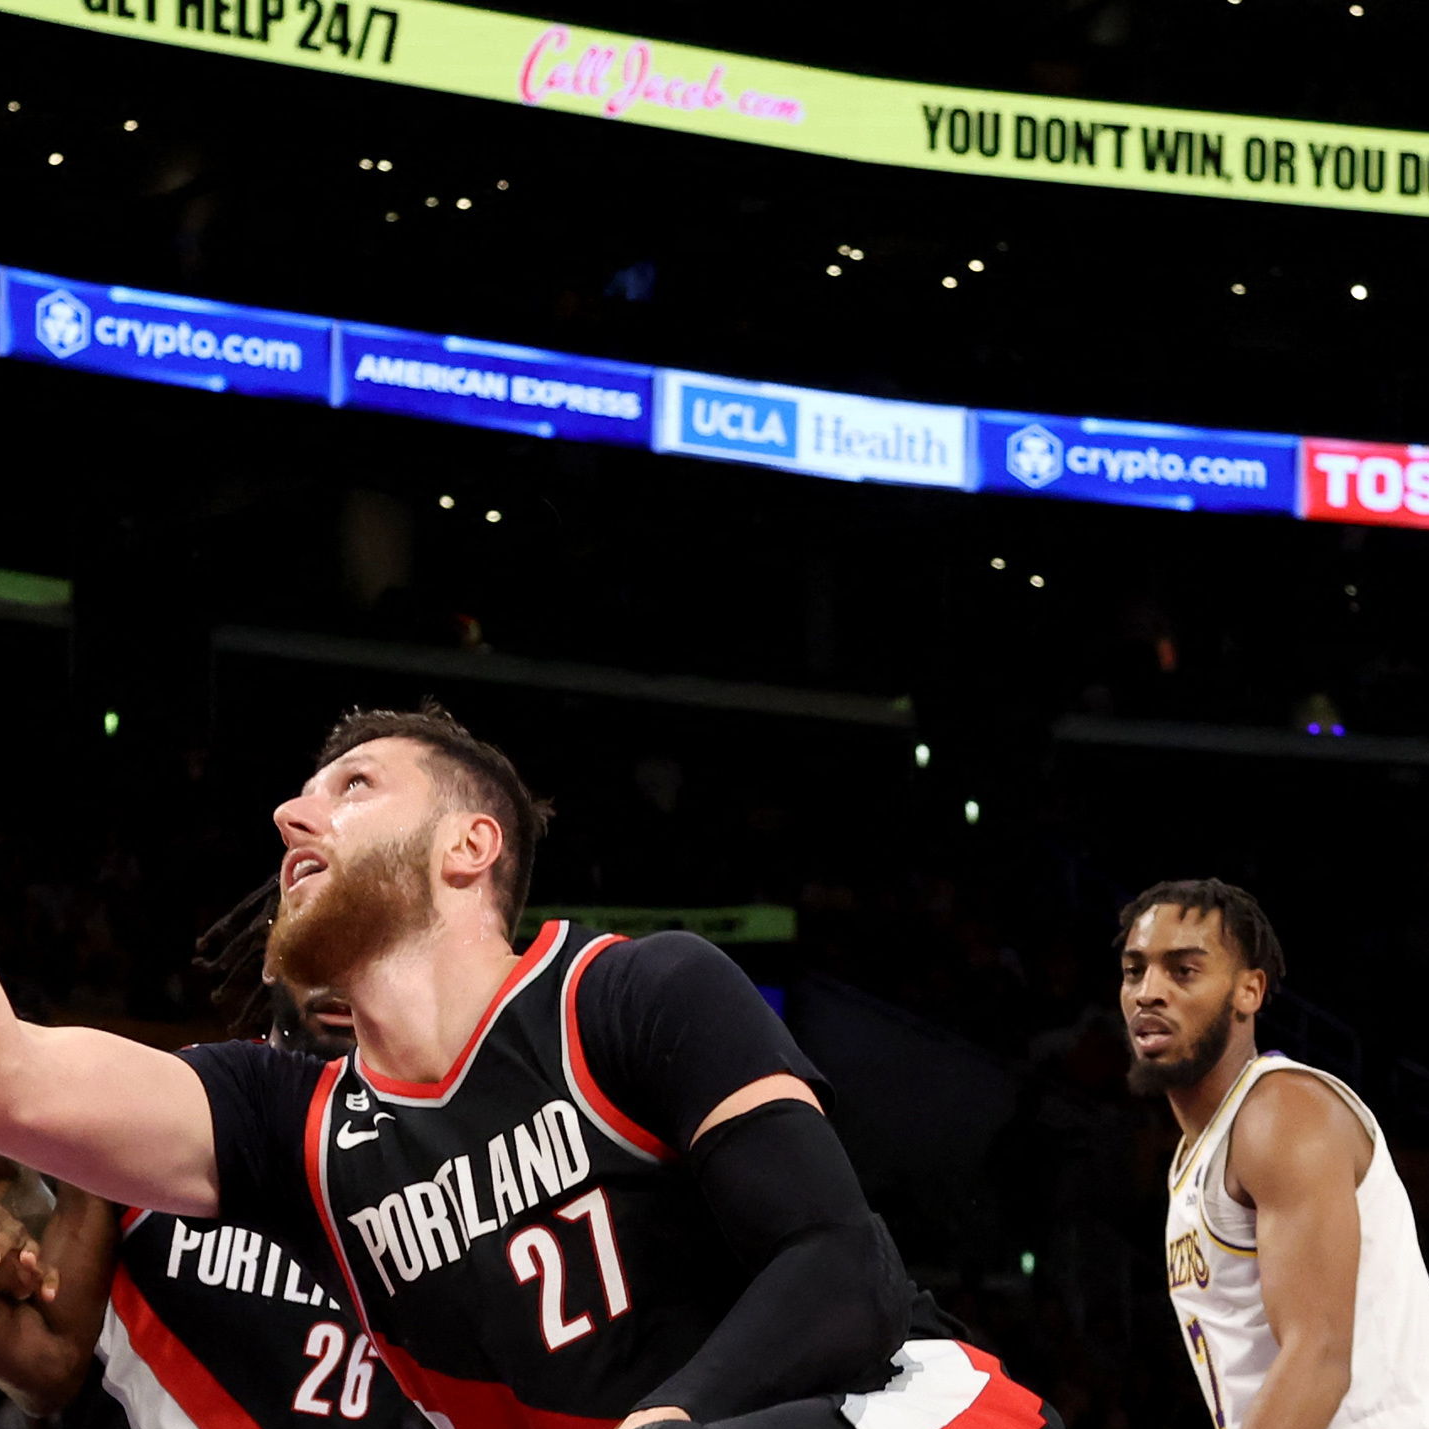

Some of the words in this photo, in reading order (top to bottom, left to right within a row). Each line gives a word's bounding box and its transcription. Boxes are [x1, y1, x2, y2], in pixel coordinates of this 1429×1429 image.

[922, 104, 1001, 158] YOU
[1015, 114, 1130, 170] DON'T
[1140, 125, 1233, 183] WIN,
[1243, 136, 1298, 185] OR
[1308, 142, 1385, 195] YOU
[94, 315, 303, 373] crypto.com
[354, 353, 510, 402] AMERICAN
[511, 376, 642, 421] EXPRESS
[691, 397, 788, 446] UCLA
[811, 413, 949, 467] Health
[1064, 443, 1267, 489] crypto.com
[346, 1098, 592, 1298] PORTLAND
[505, 1185, 632, 1354] 27
[1169, 1226, 1212, 1292] KERS
[291, 1320, 380, 1420] 26
